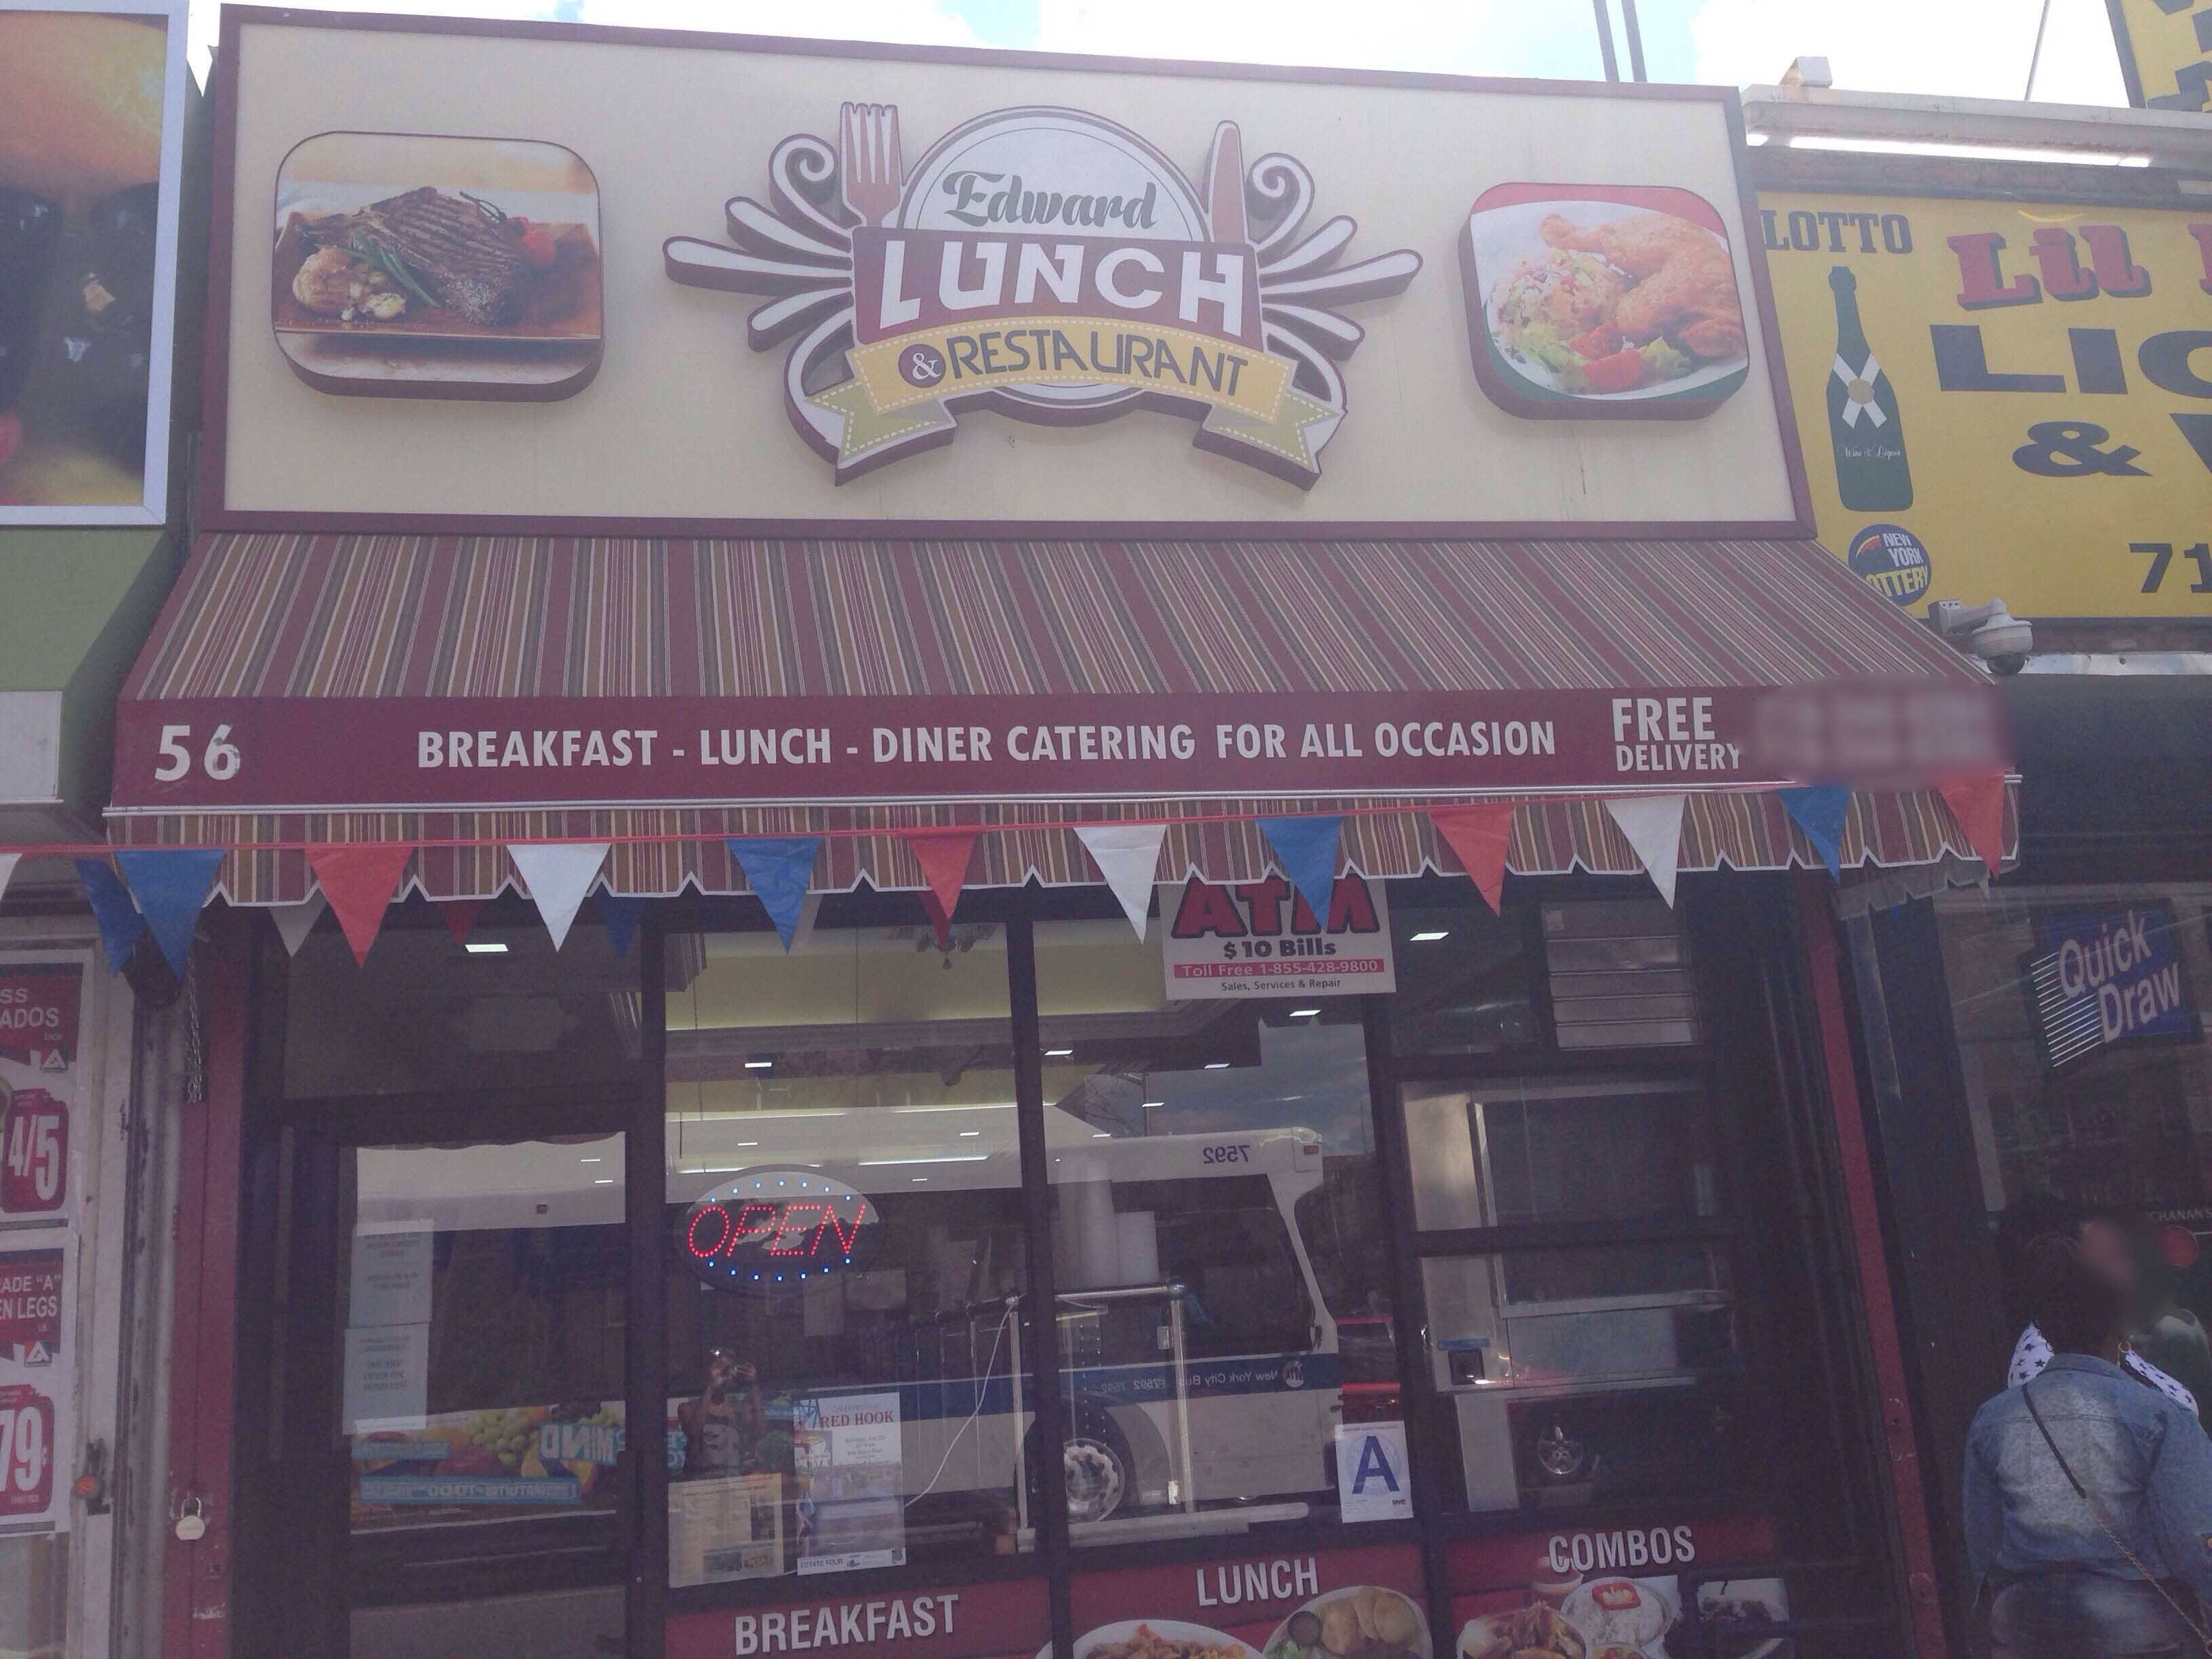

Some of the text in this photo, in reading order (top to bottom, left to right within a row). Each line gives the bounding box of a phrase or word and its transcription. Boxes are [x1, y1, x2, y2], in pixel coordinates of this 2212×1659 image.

[943, 170, 1158, 229] Edward
[1760, 209, 1914, 254] LOTTO
[880, 240, 1246, 337] LUNCH
[947, 329, 1248, 396] RESTAURANT
[2012, 420, 2154, 477] &
[1882, 533, 1912, 548] NEW
[1887, 546, 1924, 567] YORK
[1866, 565, 1928, 597] OTTERY
[1612, 696, 1717, 742] FREE
[417, 729, 658, 768] BREAKFAST
[700, 728, 831, 765] LUNCH
[872, 726, 994, 763] DINER
[1006, 724, 1196, 761] CATERING
[1216, 723, 1286, 758] FOR
[1300, 723, 1363, 758] ALL
[1374, 721, 1557, 758] OCCASION
[1616, 743, 1742, 772] DELIVERY
[1182, 960, 1378, 977] Toll Free 1-855-428-9800
[1279, 938, 1337, 958] Bills
[2059, 909, 2154, 999] Quick
[1221, 978, 1342, 991] Sales, Services & Repair
[2099, 961, 2183, 1044] Draw
[8, 1113, 60, 1201] 4/5
[687, 1203, 867, 1258] OPEN
[18, 1295, 58, 1319] LEGS
[821, 1410, 894, 1429] RED HOOK
[1352, 1435, 1400, 1494] A
[1547, 1525, 1696, 1574] COMBOS
[1195, 1557, 1319, 1608] LUNCH
[735, 1593, 960, 1657] BREAKFAST
